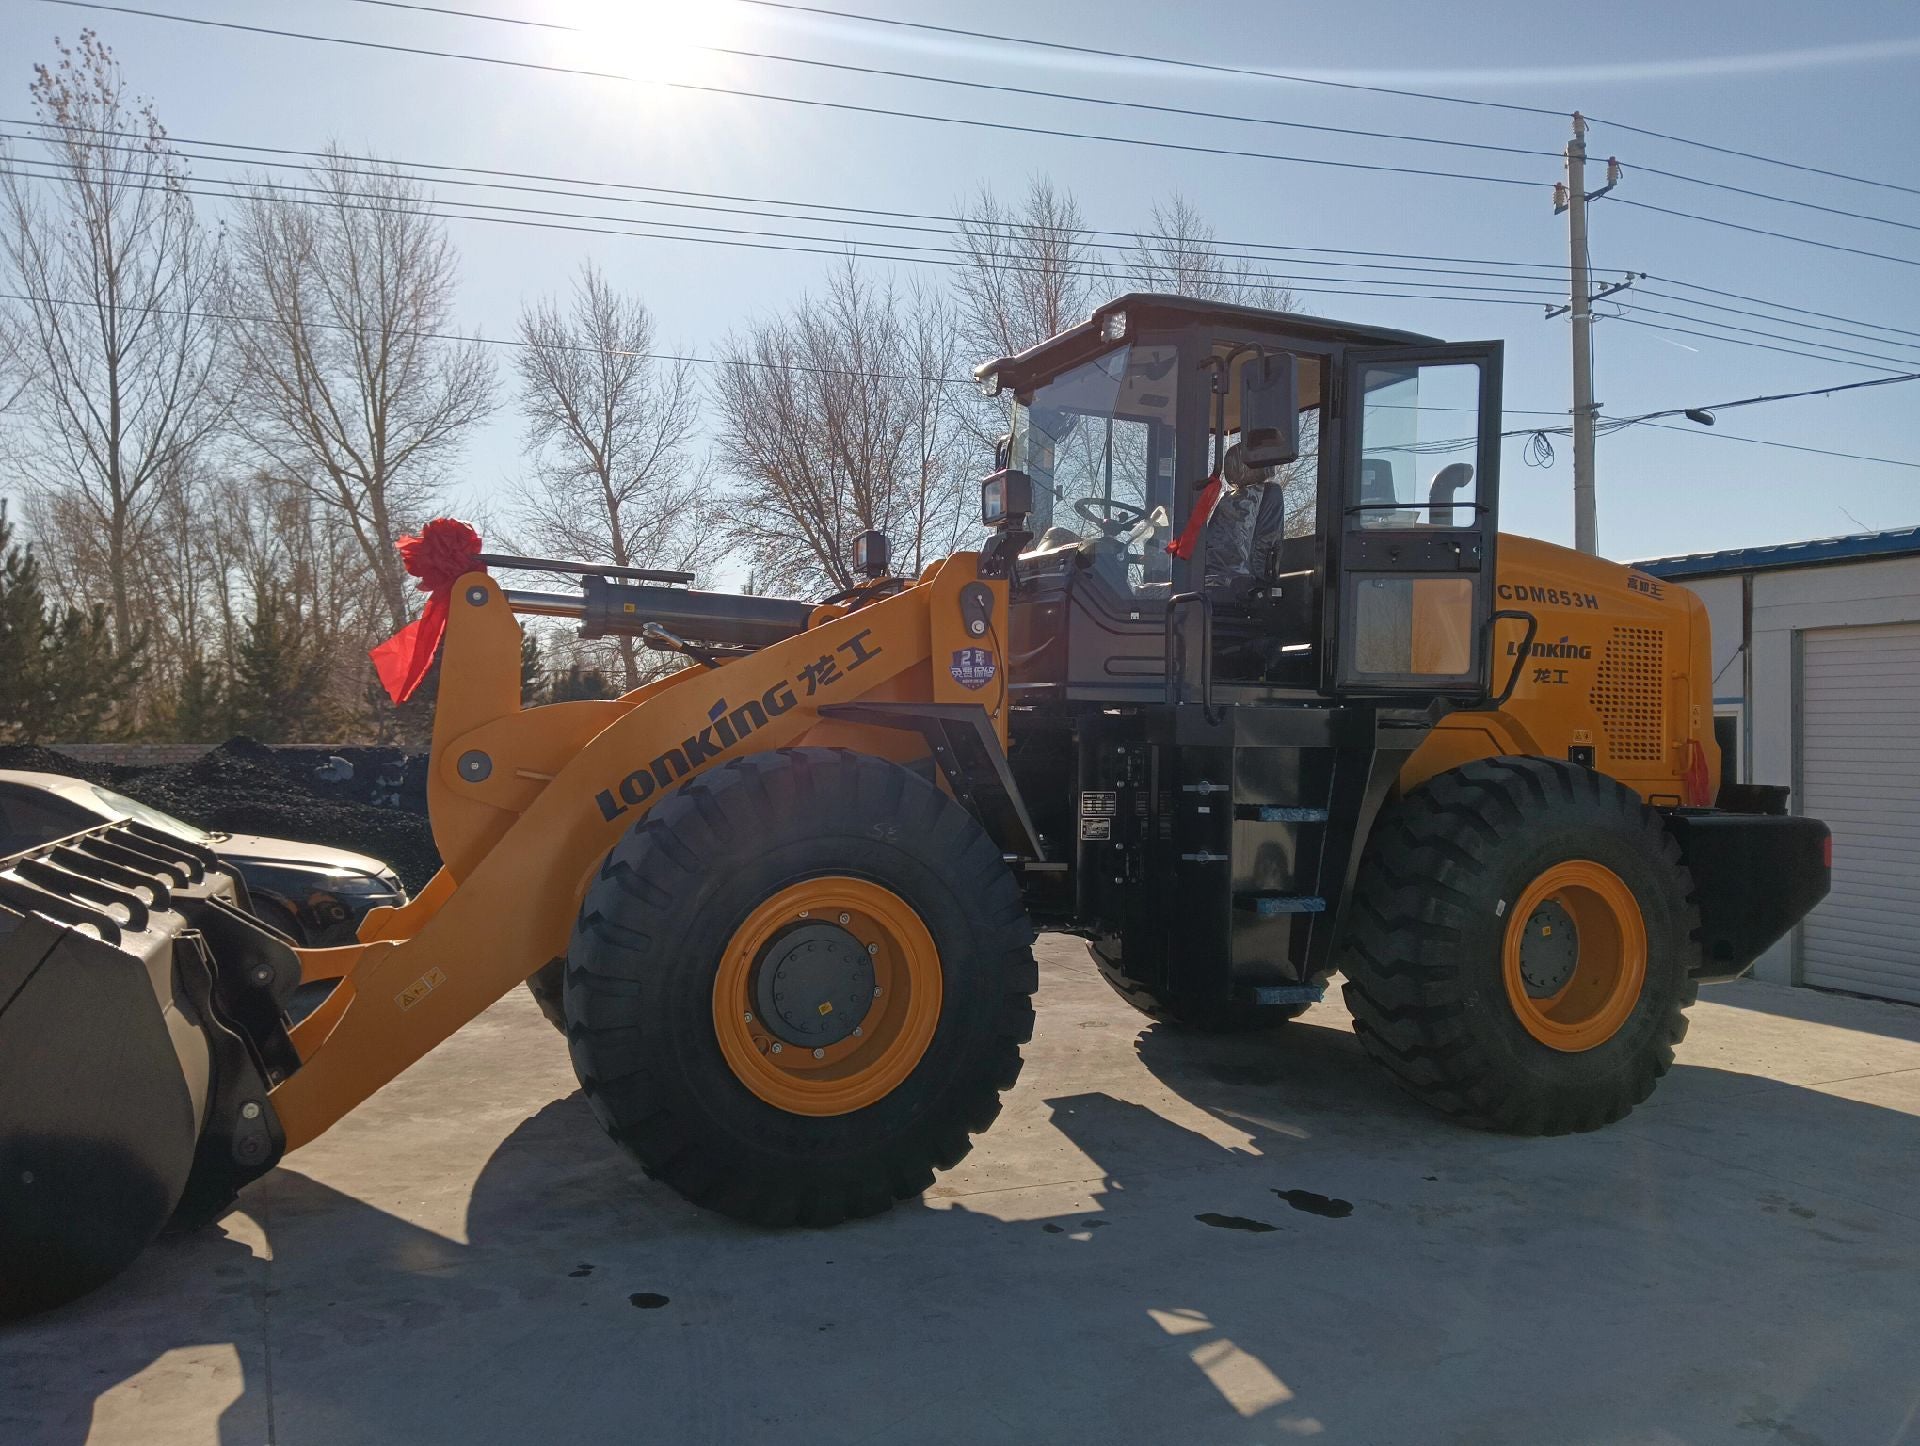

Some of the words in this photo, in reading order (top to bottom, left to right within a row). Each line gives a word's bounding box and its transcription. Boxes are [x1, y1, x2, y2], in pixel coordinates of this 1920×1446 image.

[1497, 584, 1599, 610] CDM853H
[796, 628, 882, 696] 龙工
[1533, 668, 1569, 684] 龙工
